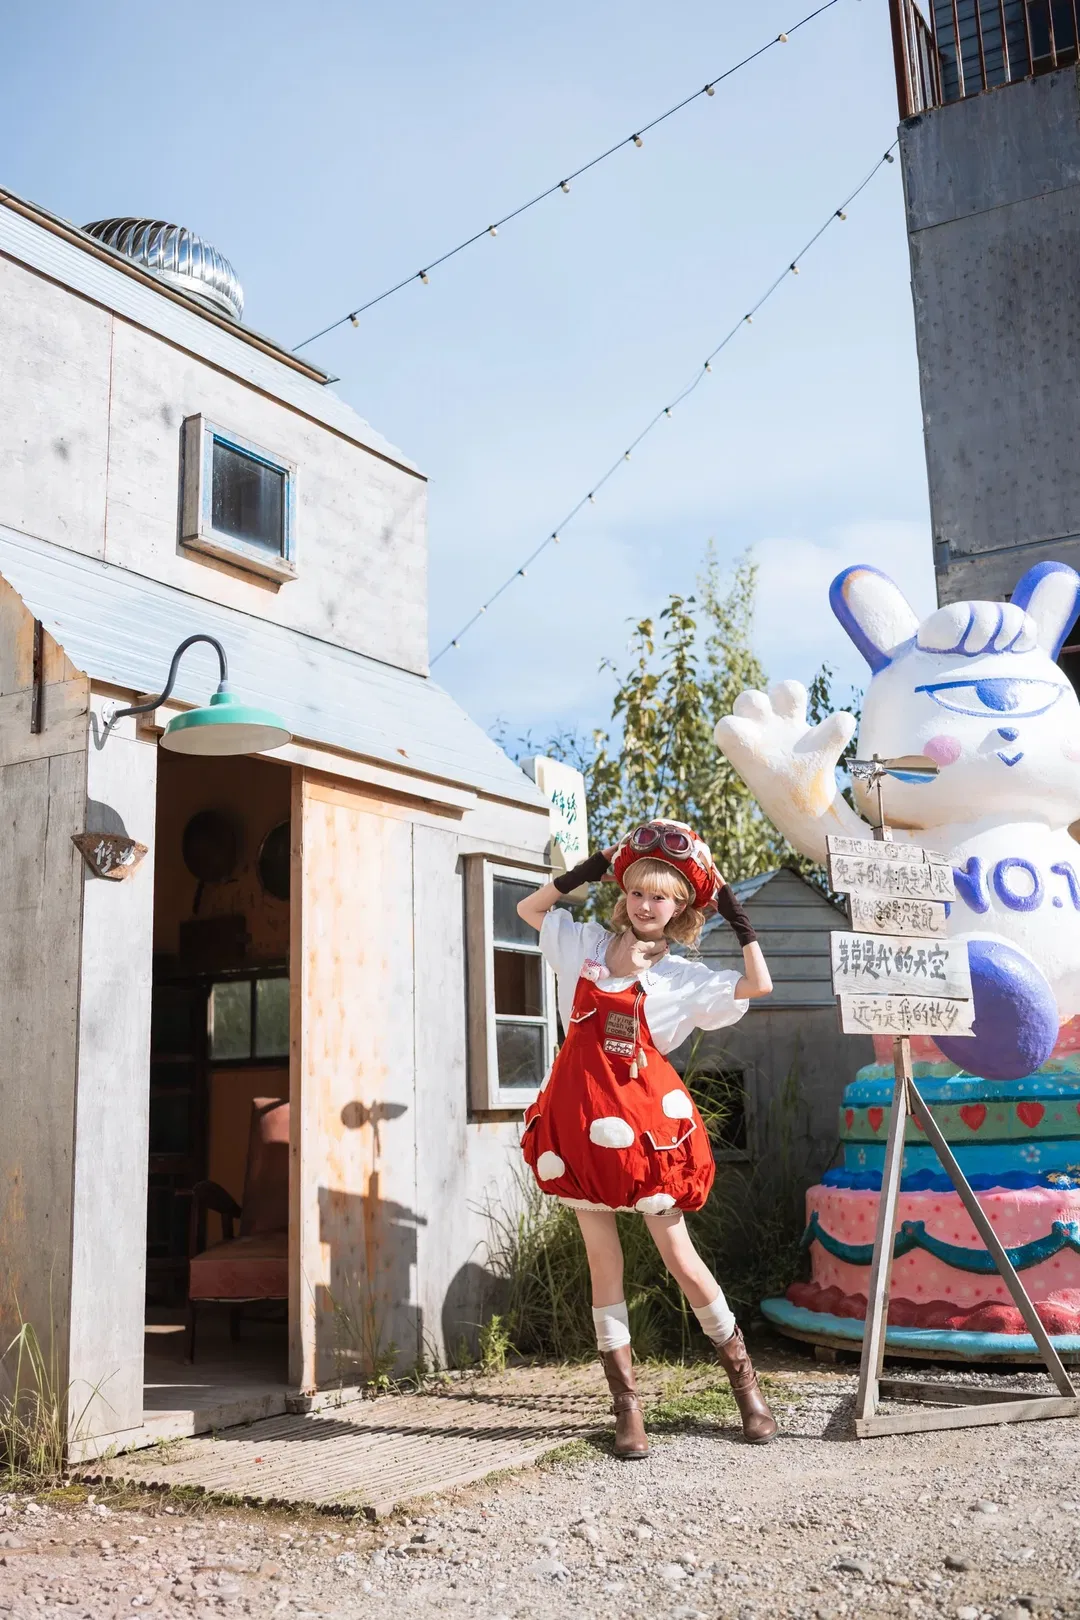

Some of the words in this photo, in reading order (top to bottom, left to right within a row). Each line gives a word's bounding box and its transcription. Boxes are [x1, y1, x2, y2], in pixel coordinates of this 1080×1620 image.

[852, 998, 959, 1031] 远方是我的故乡
